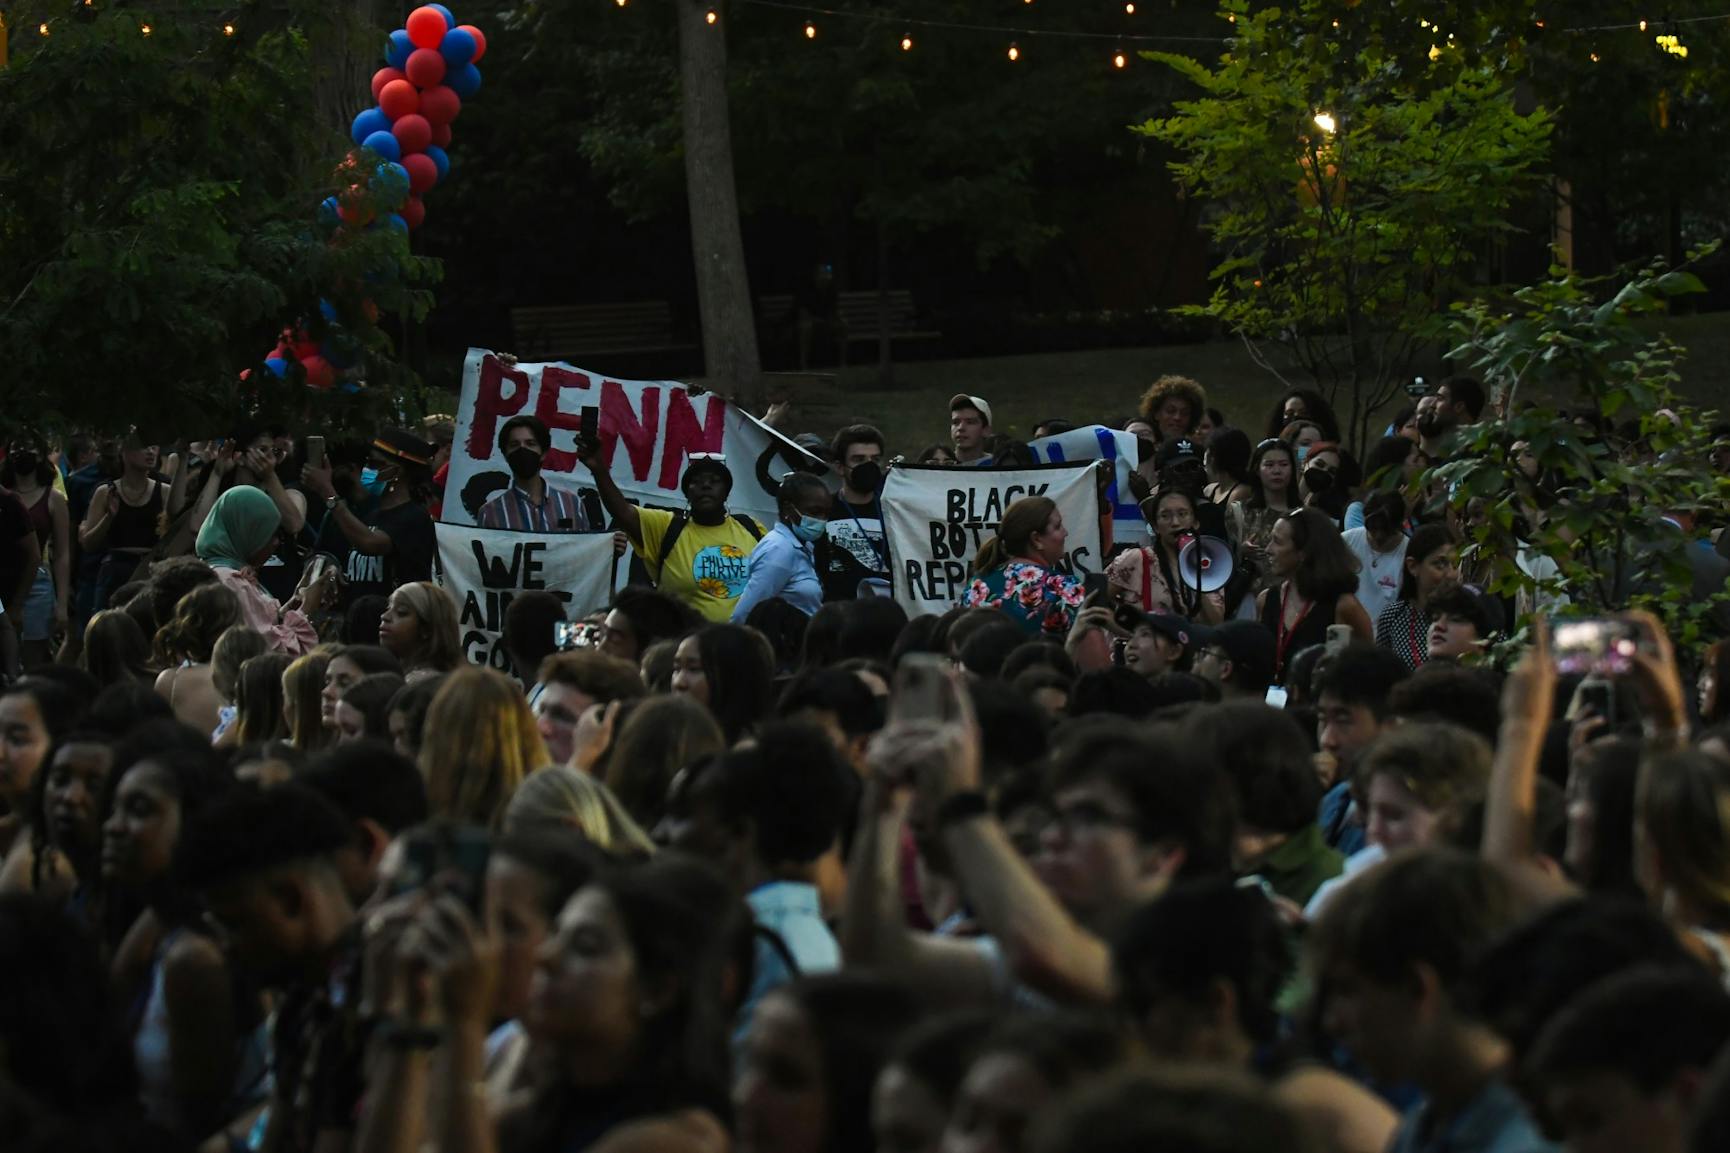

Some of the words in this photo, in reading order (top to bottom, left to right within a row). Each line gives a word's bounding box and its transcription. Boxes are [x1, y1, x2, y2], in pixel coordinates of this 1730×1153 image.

[466, 354, 728, 491] PENN
[471, 540, 546, 589] WE
[698, 566, 747, 579] THRIVE
